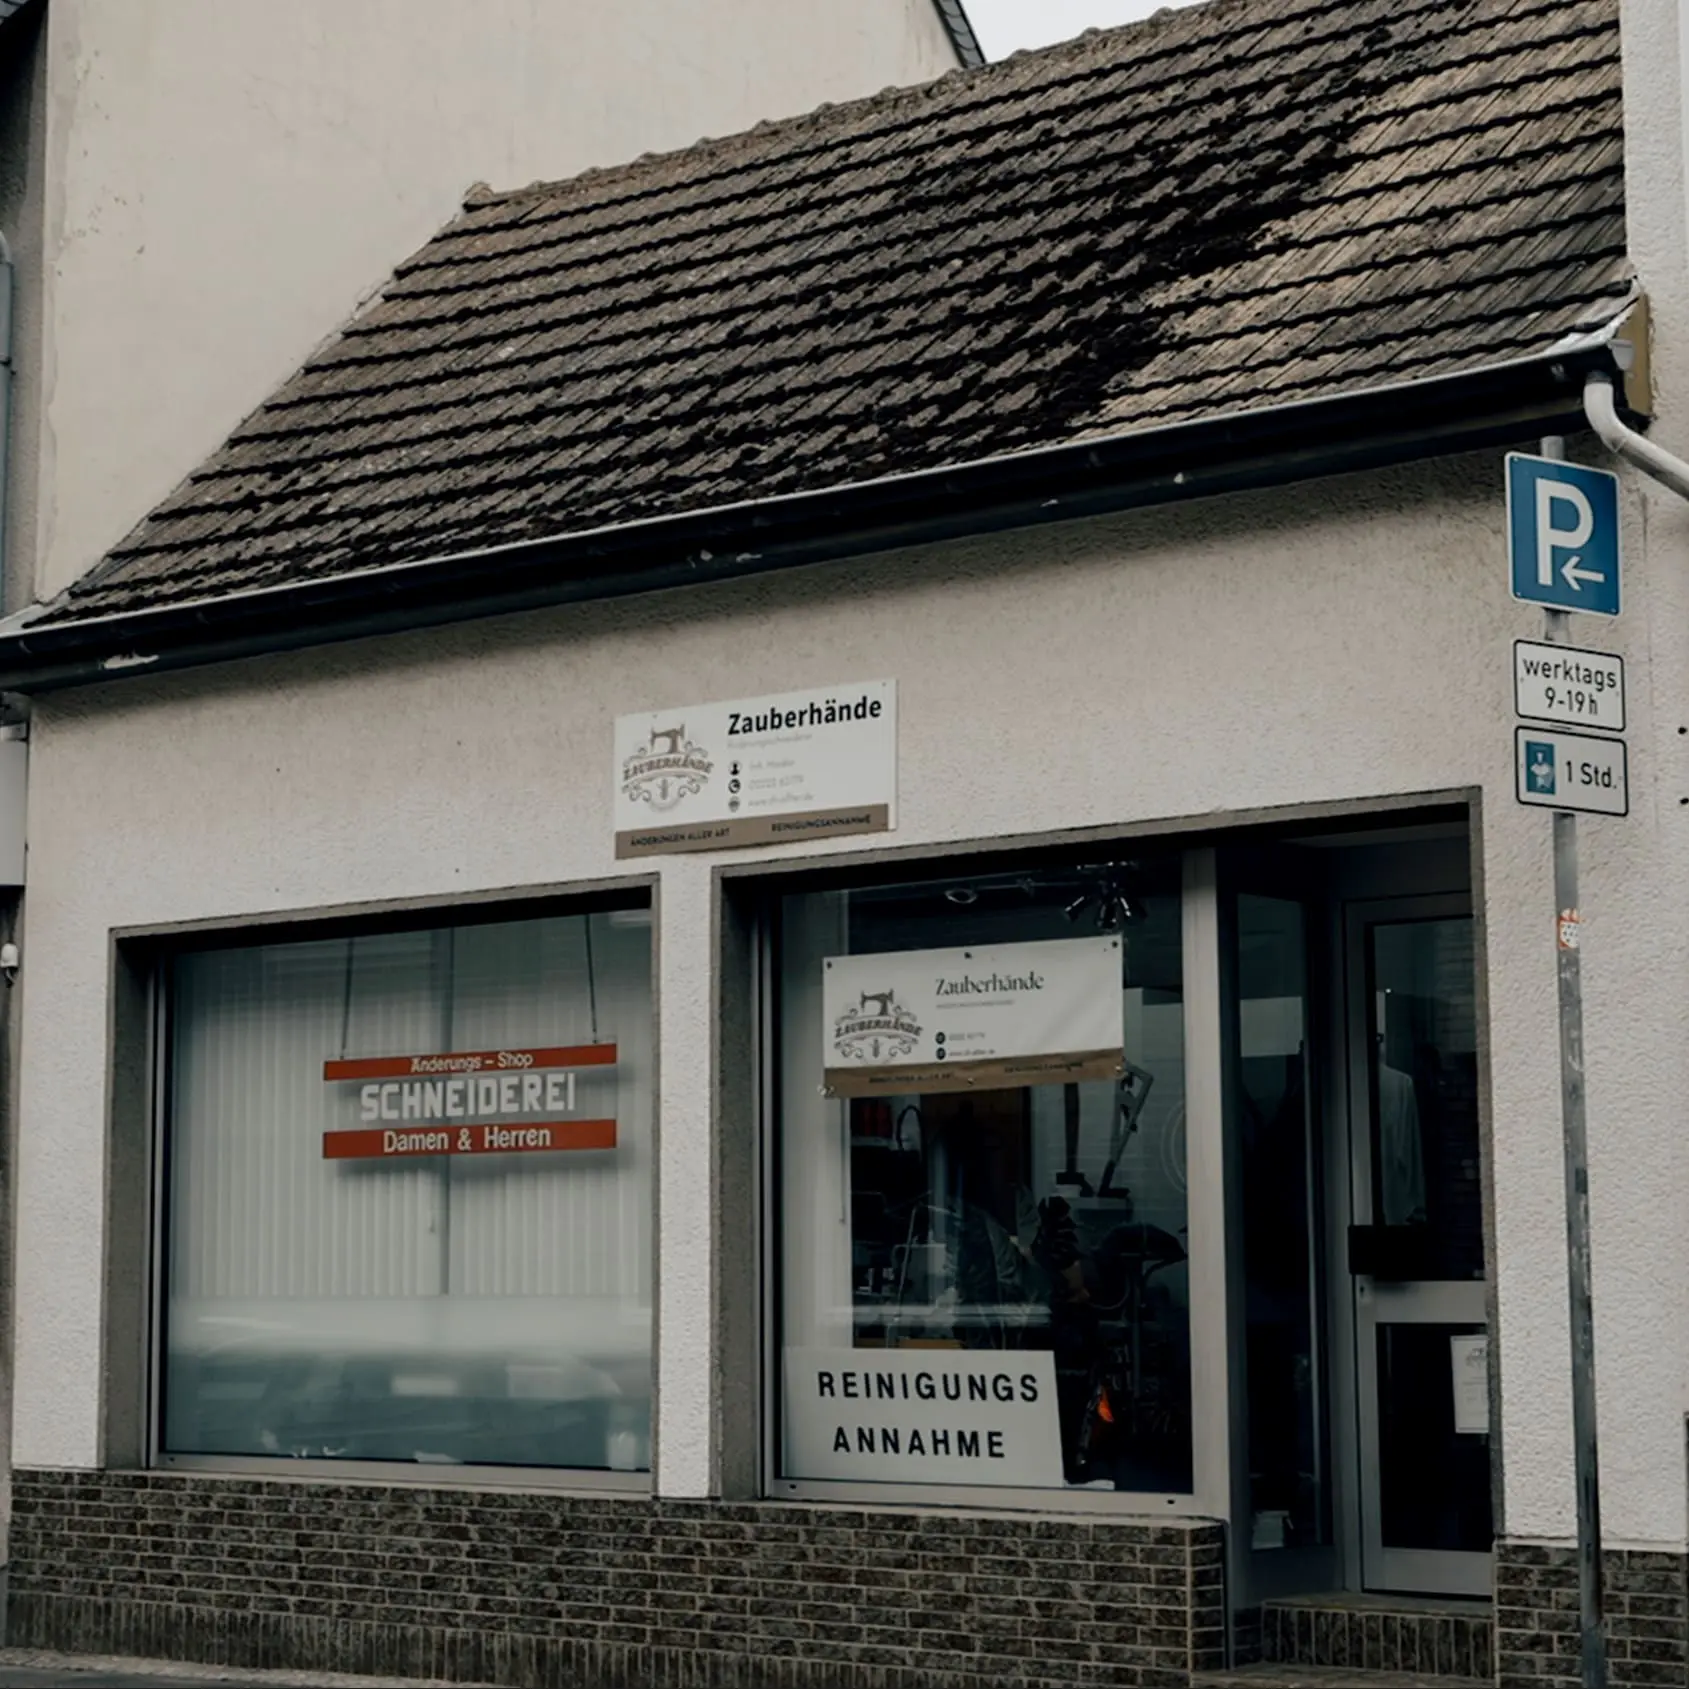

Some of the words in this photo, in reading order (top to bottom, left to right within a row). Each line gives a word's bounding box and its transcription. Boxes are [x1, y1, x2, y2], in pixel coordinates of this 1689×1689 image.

[1535, 477, 1594, 586] P
[1522, 658, 1617, 693] werktags
[728, 695, 883, 736] Zauberhände
[1565, 760, 1574, 784] 1
[1580, 762, 1618, 789] Std.
[935, 970, 1045, 996] Zauberhände
[497, 1051, 533, 1068] Shop
[360, 1072, 576, 1121] SCHNEIDEREI
[383, 1130, 449, 1153] Damen
[457, 1127, 472, 1151] &
[484, 1125, 551, 1149] Herren
[817, 1371, 1039, 1402] REINIGUNGS
[832, 1426, 1006, 1459] ANNAHME
